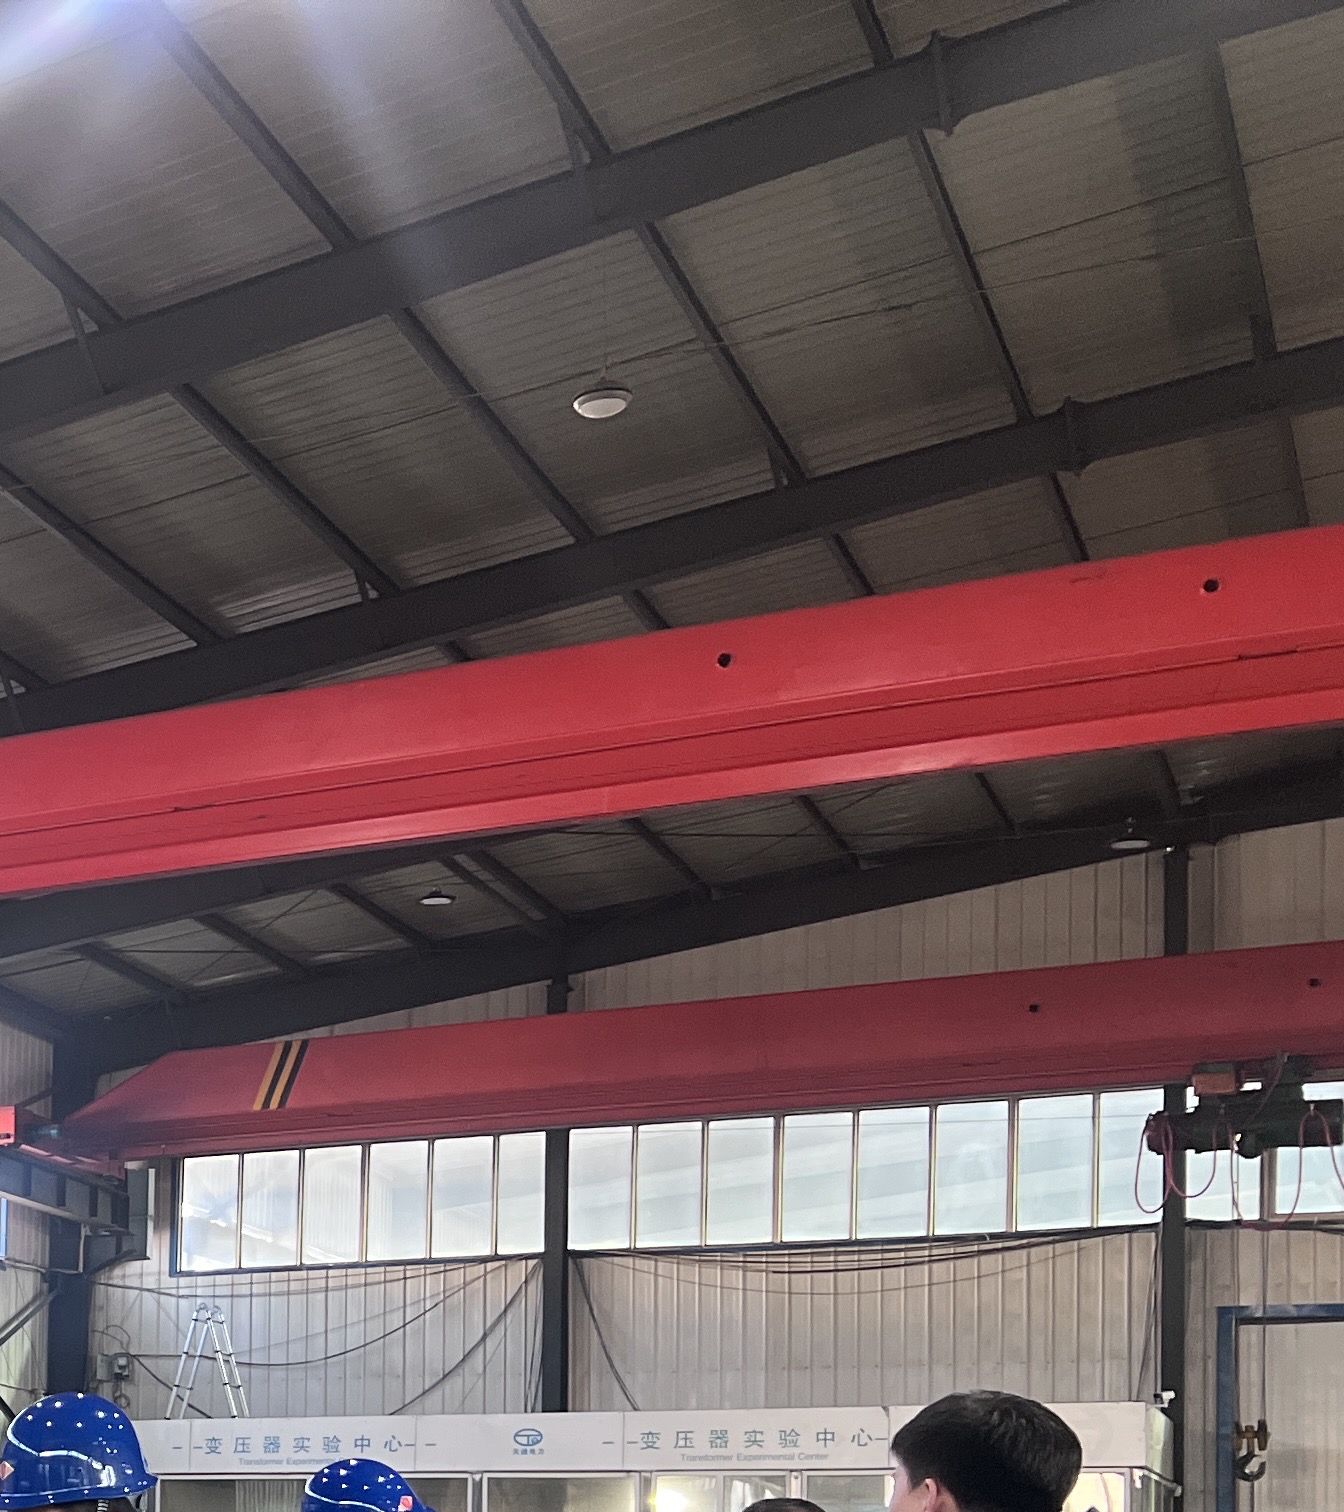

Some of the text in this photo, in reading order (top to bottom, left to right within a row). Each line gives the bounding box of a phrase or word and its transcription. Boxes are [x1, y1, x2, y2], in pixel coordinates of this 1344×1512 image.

[204, 1434, 402, 1455] 变压器实验中心
[640, 1427, 873, 1450] 变压器实验中心
[681, 1454, 733, 1462] Transformer
[798, 1452, 829, 1461] Center
